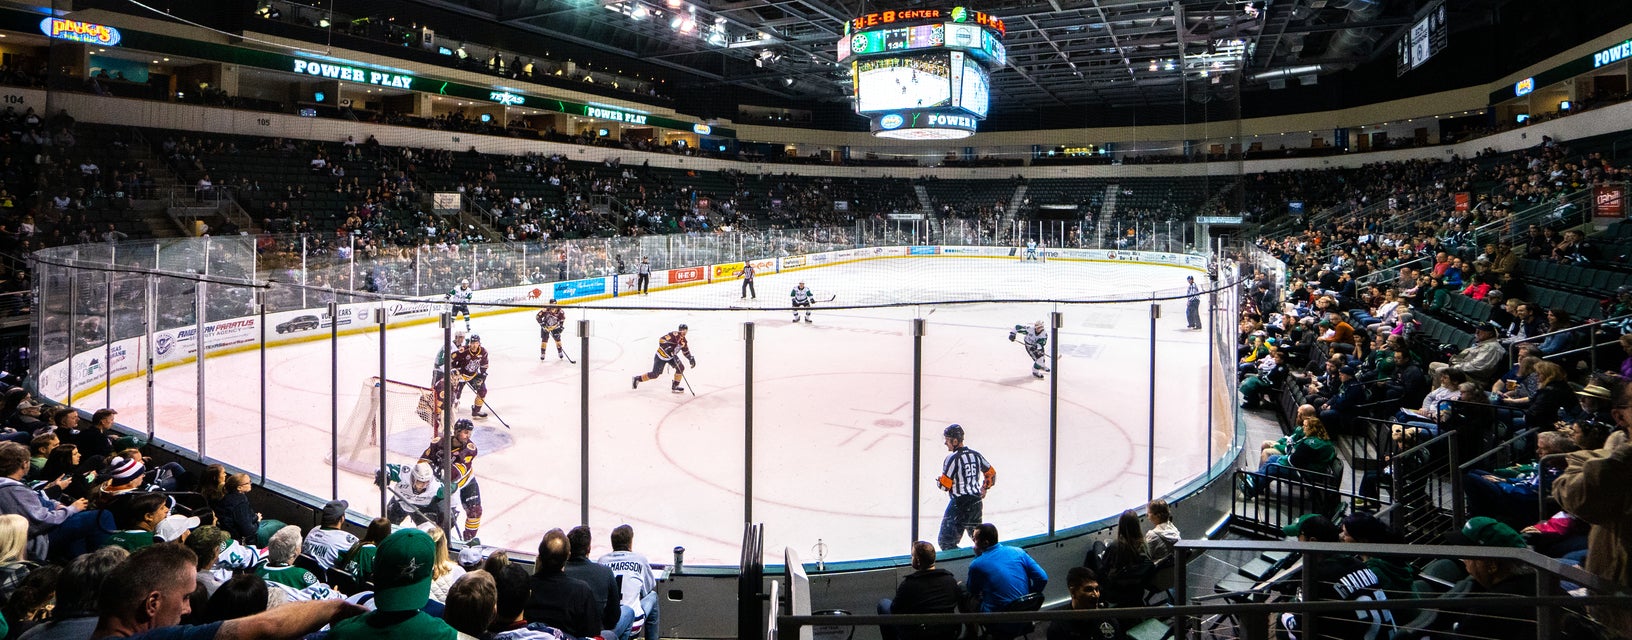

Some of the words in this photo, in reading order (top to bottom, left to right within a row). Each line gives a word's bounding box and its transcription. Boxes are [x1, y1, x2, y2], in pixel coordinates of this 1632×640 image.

[898, 10, 939, 19] CENTER
[293, 59, 365, 82] POWER
[370, 71, 412, 89] PLAY
[3, 95, 24, 104] 104
[587, 106, 623, 121] POWER
[625, 112, 647, 125] PLAY
[928, 114, 970, 127] POWER
[257, 118, 270, 126] 105
[215, 319, 254, 332] PARATUS
[216, 328, 242, 336] AGENCY
[965, 463, 977, 477] 26
[230, 551, 243, 563] 4
